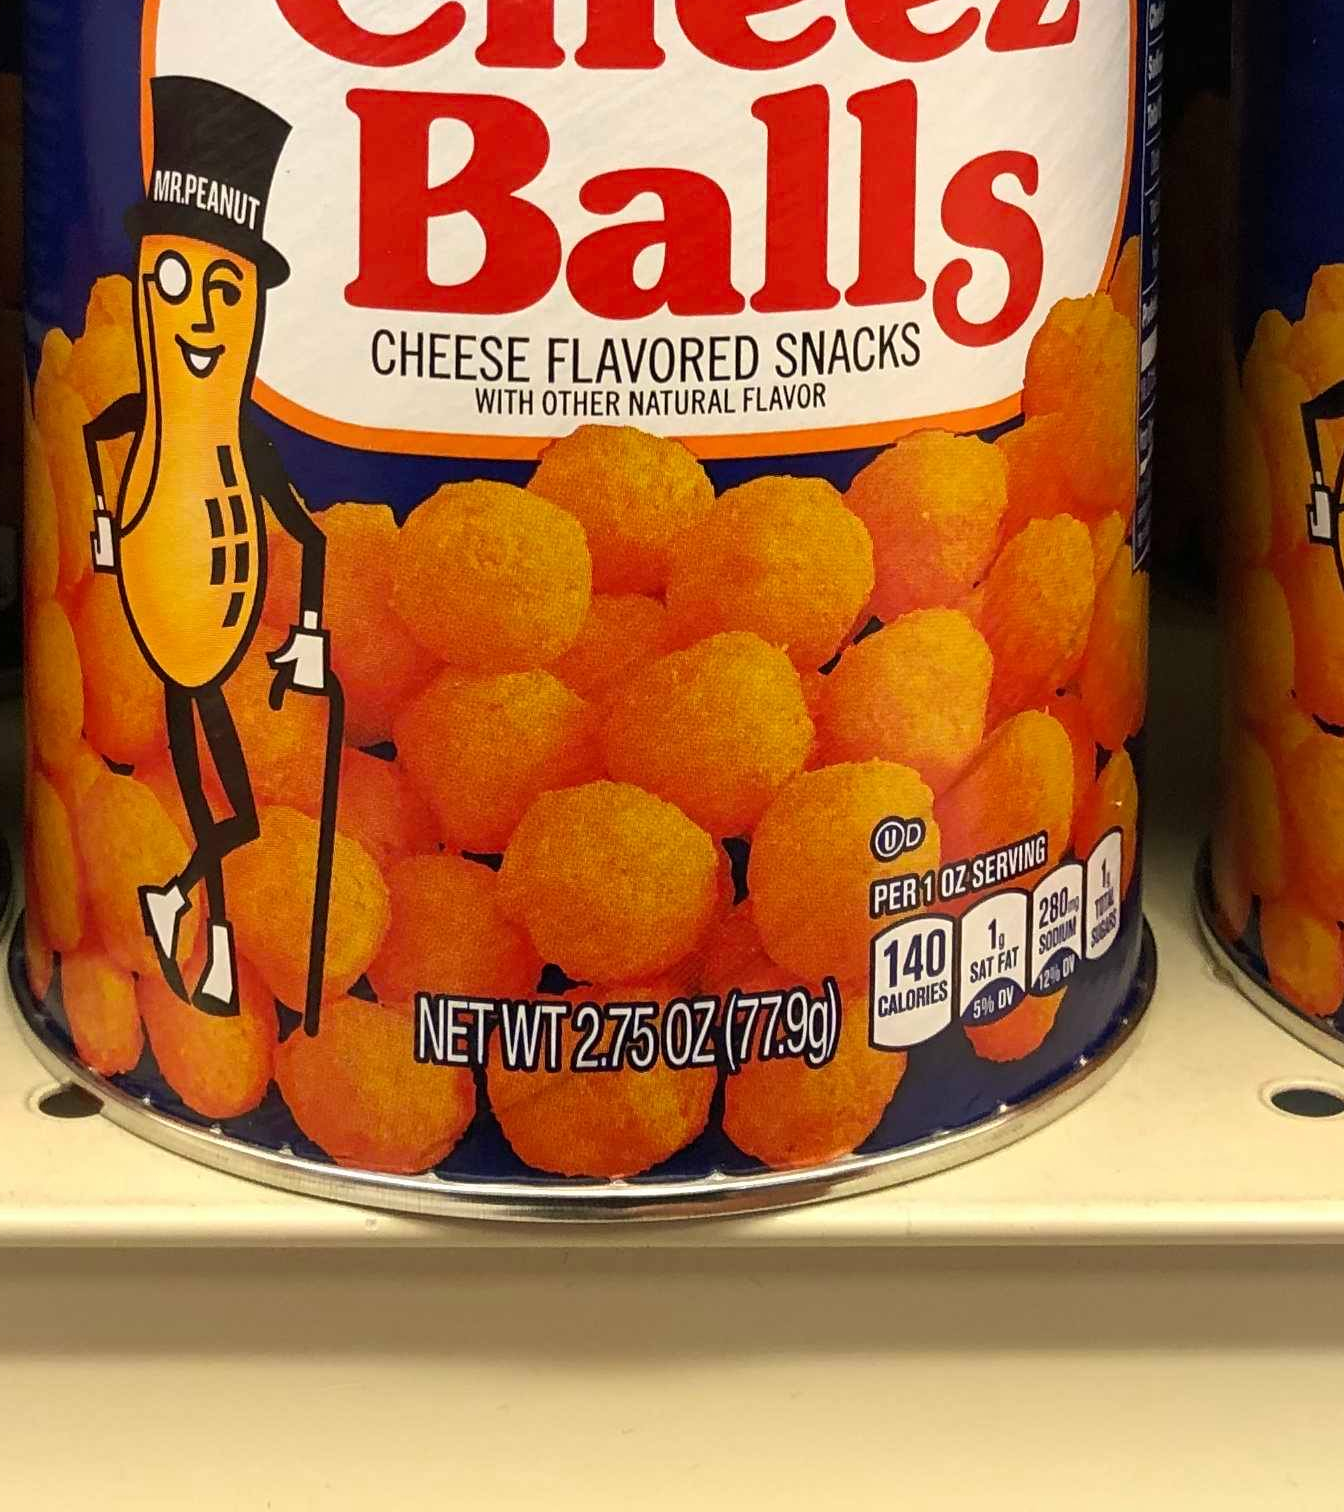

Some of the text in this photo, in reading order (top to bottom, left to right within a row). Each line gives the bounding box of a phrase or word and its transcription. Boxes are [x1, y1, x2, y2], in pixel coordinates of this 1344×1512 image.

[343, 79, 1044, 348] Balls
[371, 321, 921, 384] CHEESE FLAVORED SNACKS
[475, 383, 826, 416] WITH OTHER NATURAL FLAVOR
[874, 836, 1045, 914] PER 1 OZ SERVING
[883, 929, 945, 988] 140
[1039, 916, 1076, 954] SODIUM
[970, 946, 1019, 983] SAT FAT
[878, 980, 948, 1018] CALORIES
[973, 995, 994, 1019] 5%
[419, 982, 837, 1071] NET WT 2.75 OZ (77.9g)
